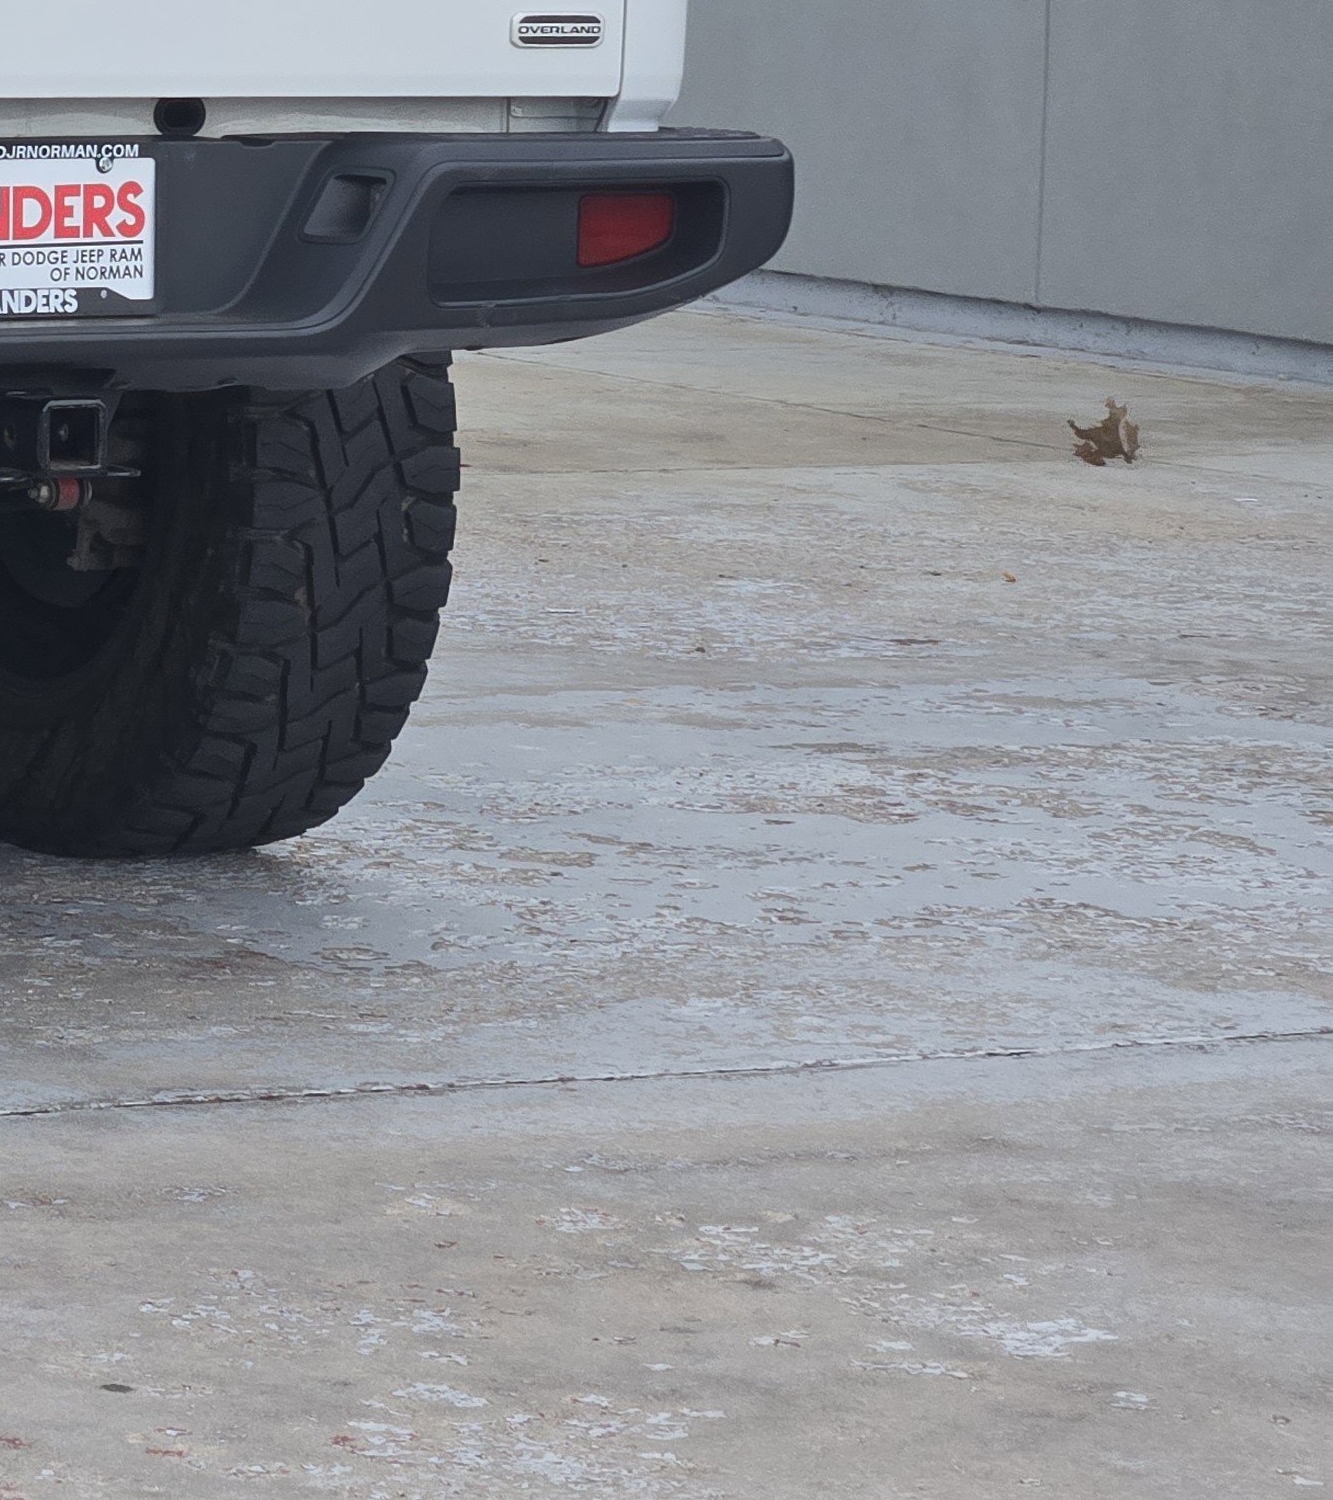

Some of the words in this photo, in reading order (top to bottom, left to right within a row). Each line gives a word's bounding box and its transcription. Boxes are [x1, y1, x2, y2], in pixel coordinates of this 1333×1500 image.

[517, 25, 601, 35] OVERLAND
[11, 250, 68, 266] DODGE
[72, 249, 105, 264] JEEP
[109, 248, 143, 263] RAM
[50, 267, 71, 282] OF
[75, 264, 144, 281] NORMAN
